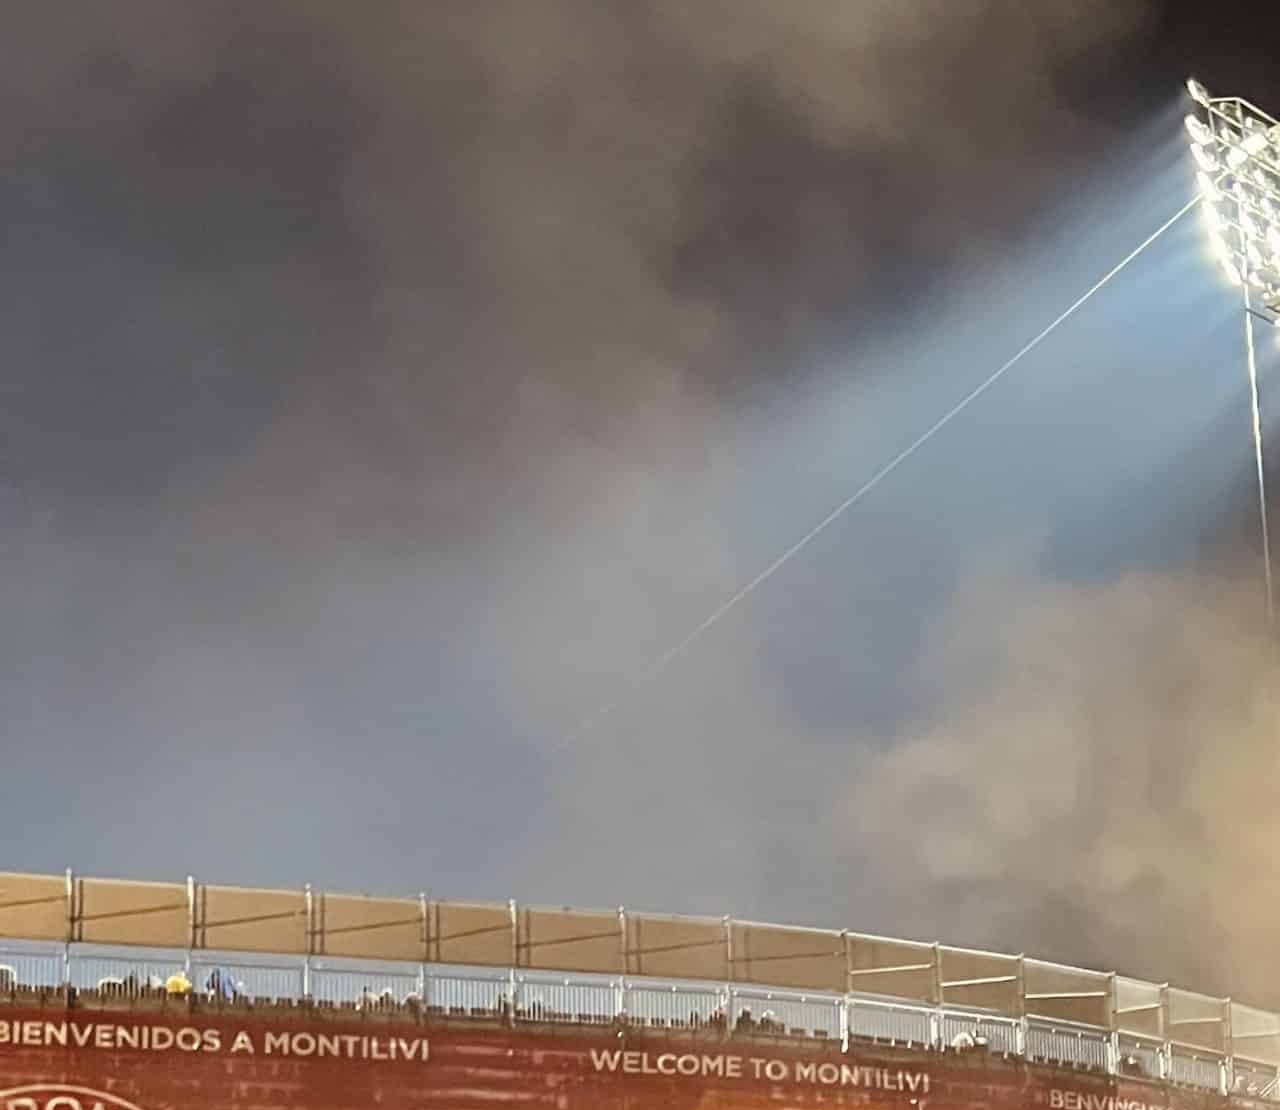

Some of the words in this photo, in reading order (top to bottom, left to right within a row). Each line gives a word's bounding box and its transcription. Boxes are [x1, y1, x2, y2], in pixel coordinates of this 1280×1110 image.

[0, 1020, 221, 1051] BIENVENIDOS
[230, 1030, 255, 1054] A
[264, 1031, 430, 1061] MONTILIVI
[589, 1048, 743, 1078] WELCOME
[750, 1057, 787, 1080] TO
[795, 1060, 930, 1093] MONTILIVI
